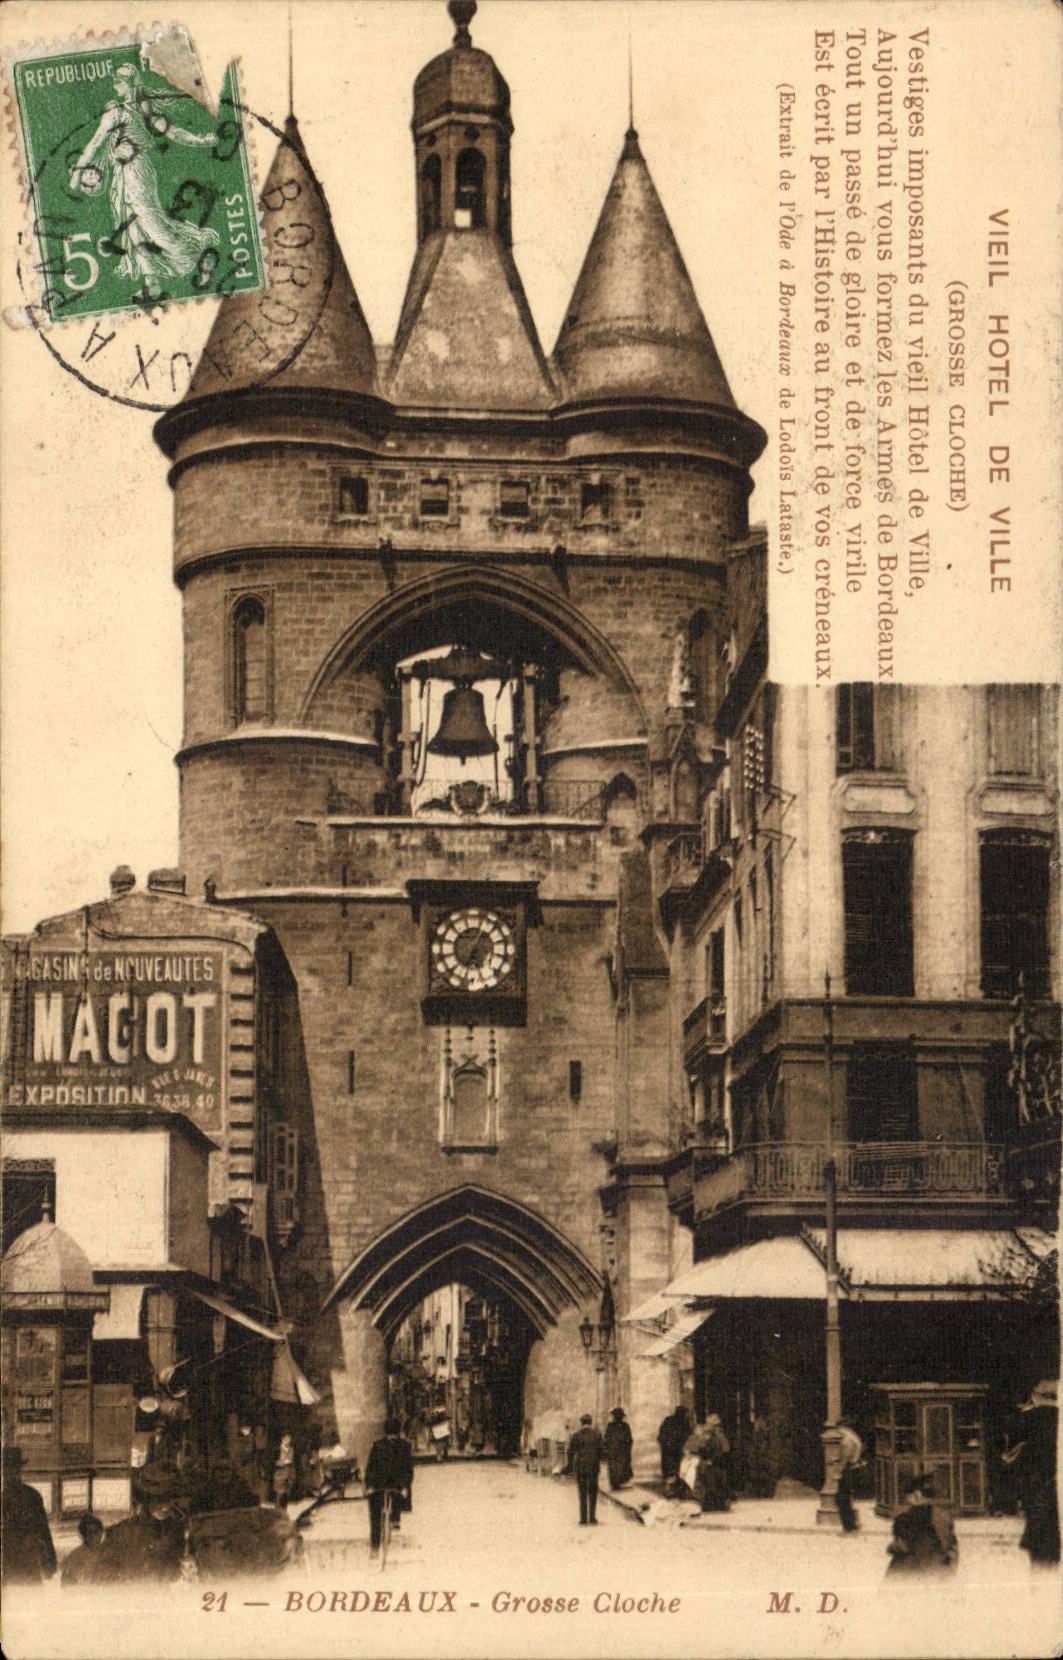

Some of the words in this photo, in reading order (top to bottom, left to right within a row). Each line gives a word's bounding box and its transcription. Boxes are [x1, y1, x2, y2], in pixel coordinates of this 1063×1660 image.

[225, 193, 254, 279] POSTES
[94, 960, 112, 981] de
[33, 992, 217, 1064] MAGOT
[9, 1083, 146, 1105] EXPOSITION
